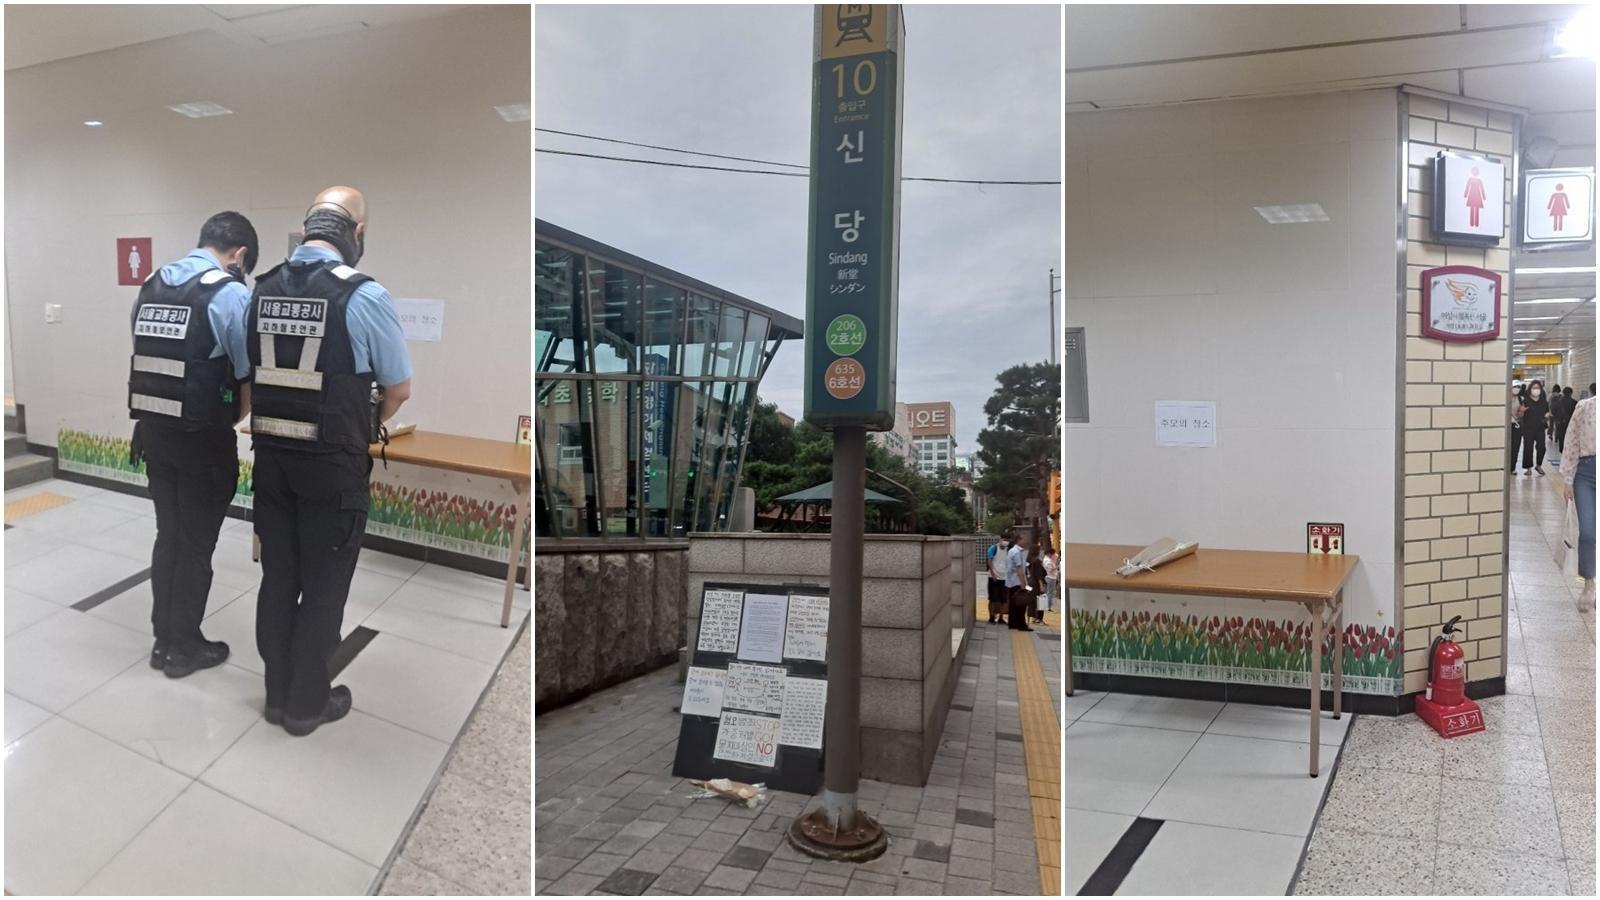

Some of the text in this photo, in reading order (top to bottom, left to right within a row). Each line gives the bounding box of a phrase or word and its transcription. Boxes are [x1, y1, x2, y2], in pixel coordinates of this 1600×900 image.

[832, 59, 877, 98] 10
[838, 100, 866, 113] 출입구
[834, 113, 870, 123] Entrance
[829, 252, 868, 265] Sindang
[829, 283, 865, 294] シンダン
[140, 308, 186, 323] 서울교통공사
[261, 302, 322, 319] 서울교통공사
[836, 320, 856, 331] 206
[831, 333, 862, 345] 2호선
[835, 363, 855, 374] 635
[829, 377, 861, 389] 6호선
[1311, 526, 1341, 536] 소화기
[755, 719, 780, 732] STOP
[1447, 712, 1481, 730] 소화기
[756, 743, 774, 755] NO
